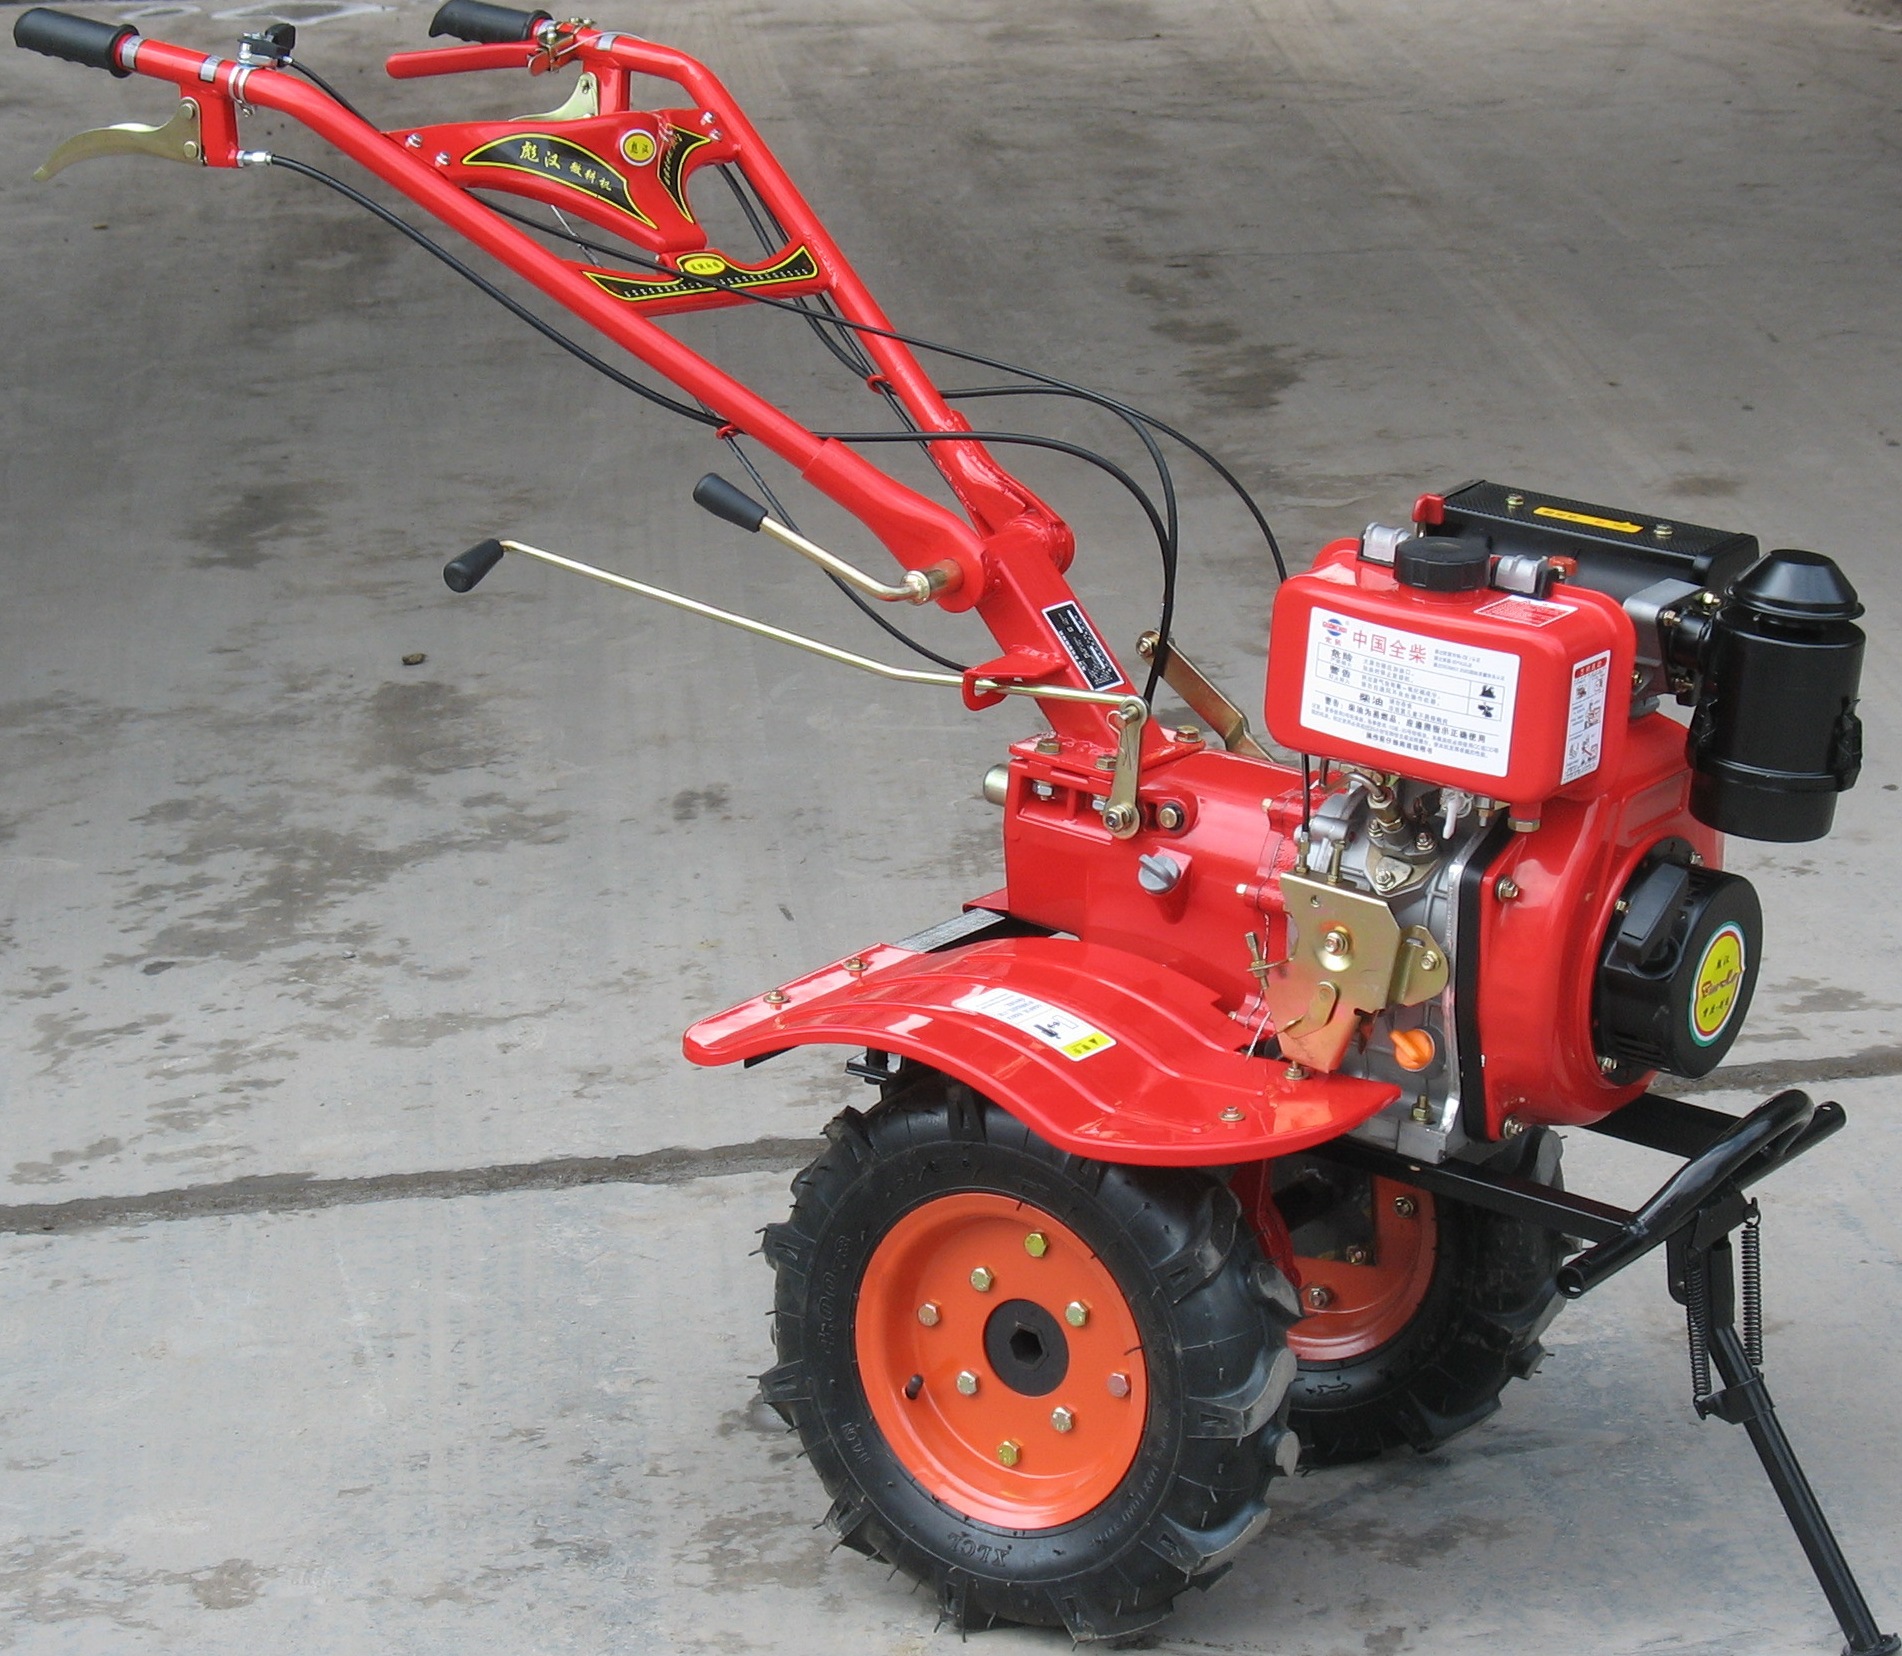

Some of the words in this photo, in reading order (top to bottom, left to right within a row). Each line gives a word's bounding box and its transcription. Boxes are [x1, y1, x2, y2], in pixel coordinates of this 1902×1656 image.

[519, 140, 561, 170] 彪汉
[1330, 648, 1353, 662] 危险
[1351, 629, 1427, 665] 中国全柴
[1358, 692, 1384, 708] 柴油
